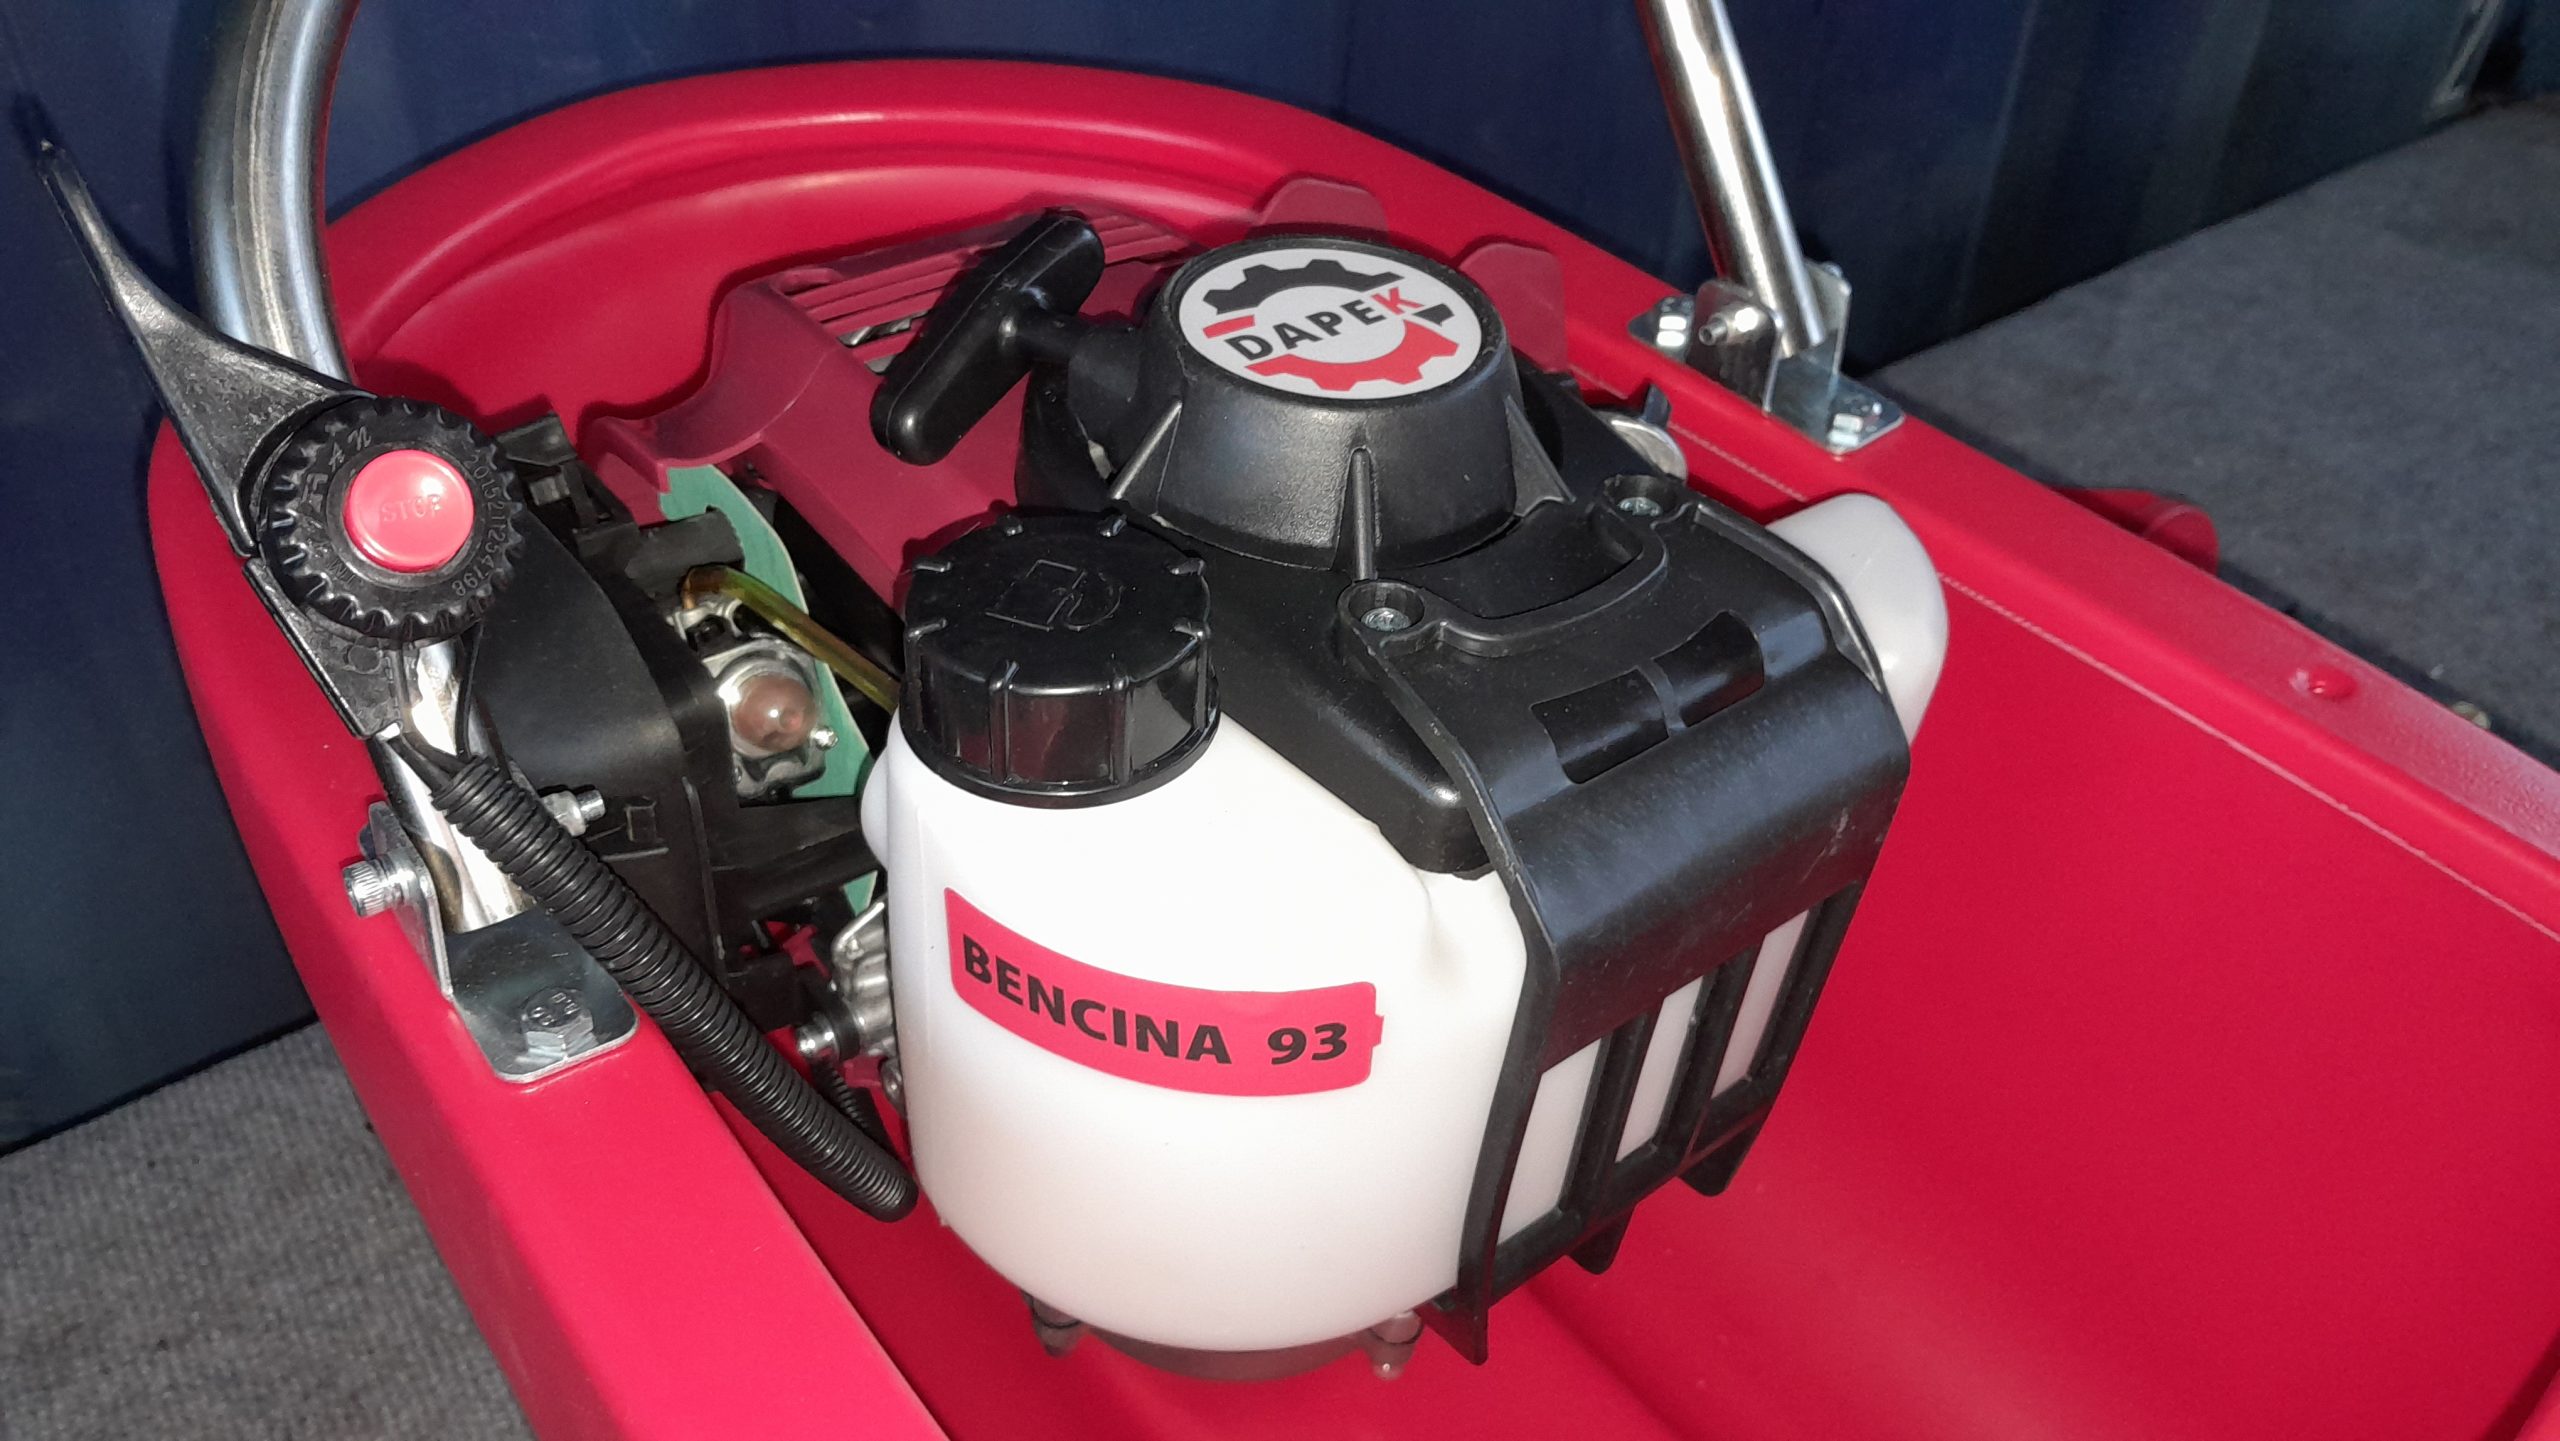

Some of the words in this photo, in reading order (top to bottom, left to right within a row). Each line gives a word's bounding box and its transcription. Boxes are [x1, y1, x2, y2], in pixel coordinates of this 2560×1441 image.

[1223, 286, 1425, 361] DAPEK
[381, 493, 441, 523] STOP
[962, 933, 1233, 1065] BENCINA
[1266, 1022, 1349, 1066] 93
